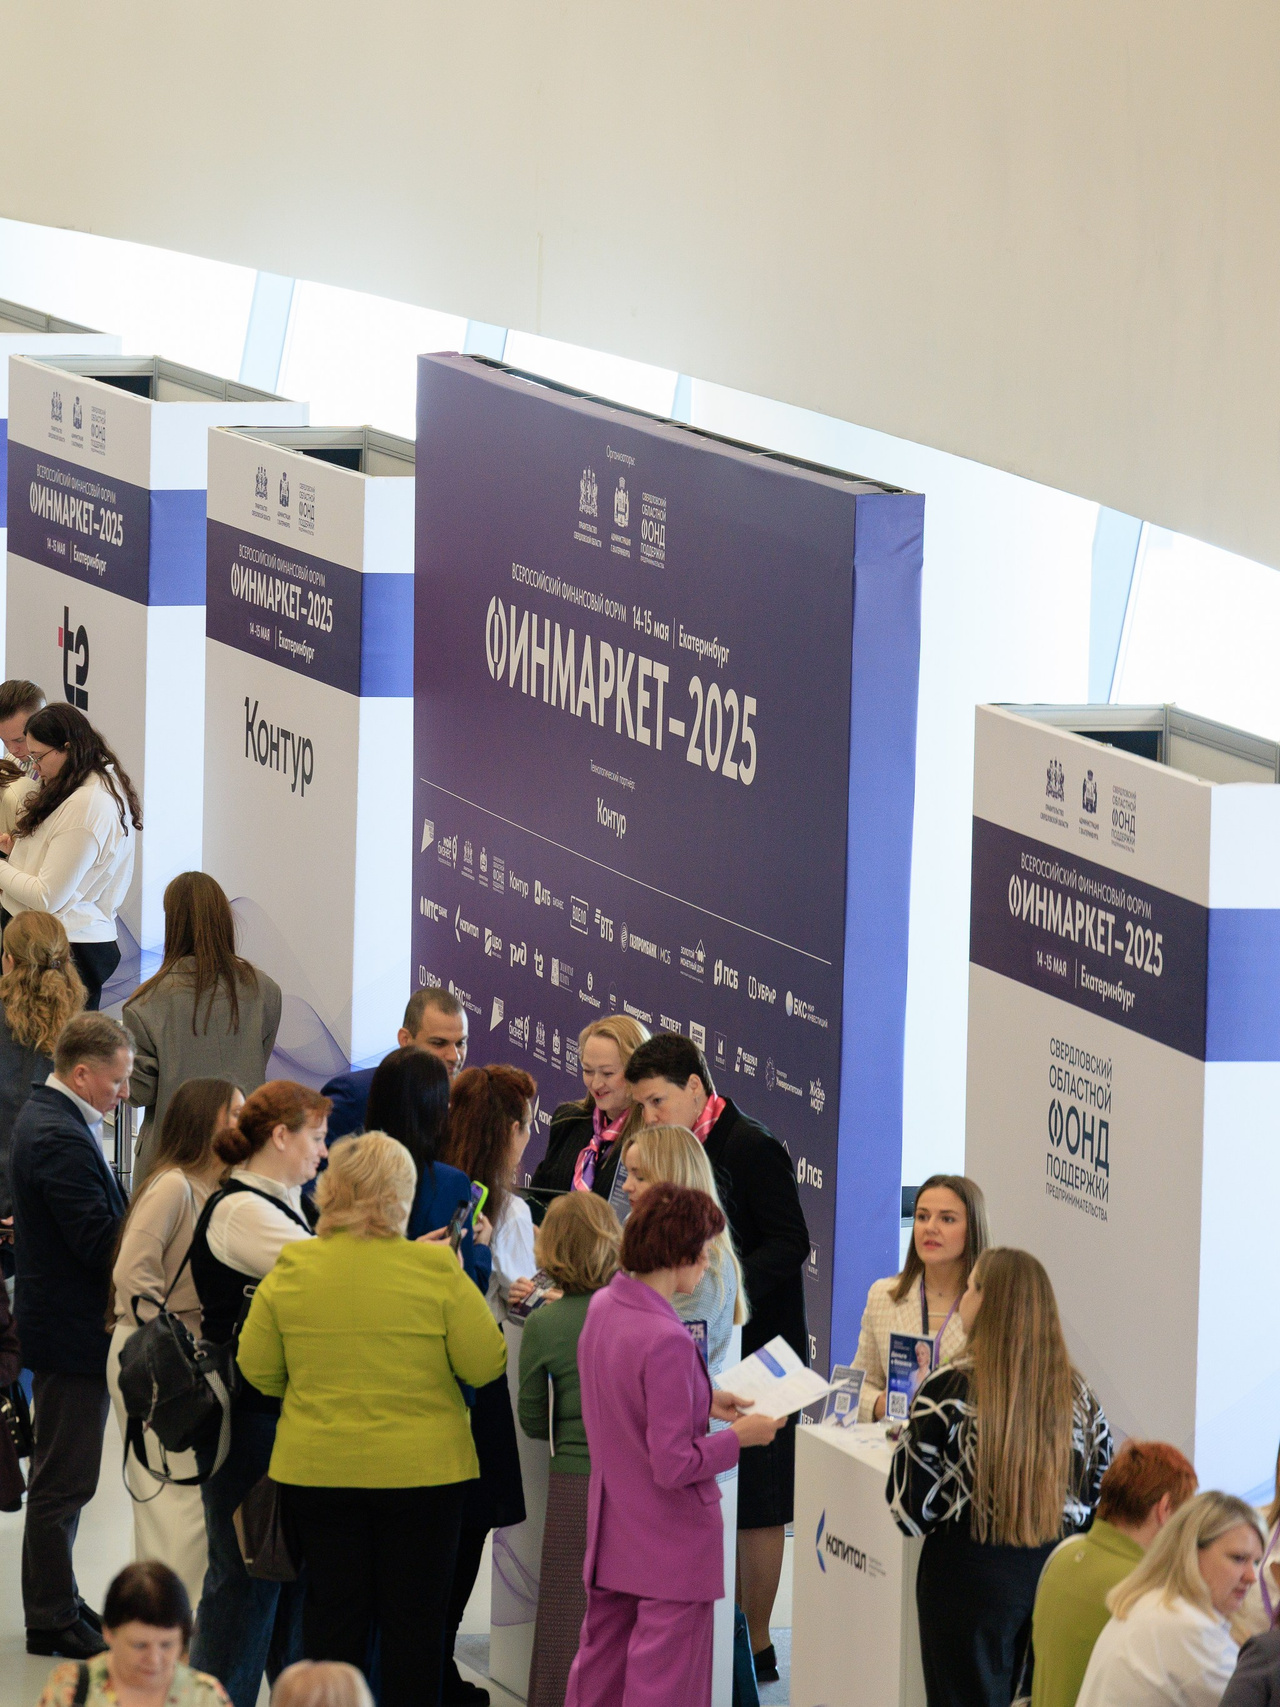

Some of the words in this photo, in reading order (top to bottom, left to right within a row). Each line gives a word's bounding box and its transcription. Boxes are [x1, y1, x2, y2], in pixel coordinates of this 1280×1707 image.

[36, 463, 71, 489] ВСЕРОССИЙСКИЙ
[641, 503, 666, 522] ОБЛАСТНОЙ
[641, 518, 666, 549] ФОНД
[73, 544, 107, 576] Екатеринбург
[239, 543, 277, 571] ВСЕРОССИЙСКИЙ
[277, 558, 309, 583] ФИНАНСОВЫЙ
[309, 569, 326, 588] ФОРУМ
[640, 542, 665, 561] ПОДДЕРЖКИ
[511, 562, 561, 598] ВСЕРОССИЙСКИЙ
[562, 581, 604, 614] ФИНАНСОВЫЙ
[604, 597, 627, 623] ФОРУМ
[632, 605, 653, 636] 14-15
[653, 618, 669, 642] мая
[678, 623, 729, 669] Екатеринбург
[278, 629, 315, 664] Екатеринбург
[244, 696, 314, 797] Контур
[597, 797, 627, 839] Контур
[1112, 796, 1137, 813] ОБЛАСТНОЙ
[1111, 807, 1136, 836] ФОНД
[1111, 828, 1136, 846] ПОДДЕРЖКИ
[509, 870, 528, 899] Контур
[1021, 851, 1077, 890] ВСЕРОССИЙСКИЙ
[1078, 874, 1126, 911] ФИНАНСОВЫЙ
[1126, 894, 1152, 921] ФОРУМ
[424, 897, 439, 922] МТС
[600, 915, 614, 942] ВТБ
[629, 933, 657, 959] ГАЗПРОМБАНК
[660, 947, 671, 965] МСБ
[723, 965, 739, 989] ПСБ
[1052, 957, 1067, 977] МАЯ
[1081, 964, 1136, 1012] Екатеринбург
[757, 982, 777, 1005] УБРиР
[793, 997, 808, 1020] БКС
[1050, 1037, 1112, 1082] СВЕРДЛОВСКИЙ
[1049, 1064, 1112, 1114] ОБЛАСТНОЙ
[1048, 1098, 1109, 1178] ФОНД
[807, 1167, 823, 1190] ПСБ
[1046, 1152, 1109, 1204] ПОДДЕРЖКИ
[1045, 1182, 1108, 1223] ПРЕДПРИНИМАТЕЛЬСТВА
[825, 1532, 867, 1574] капитал
